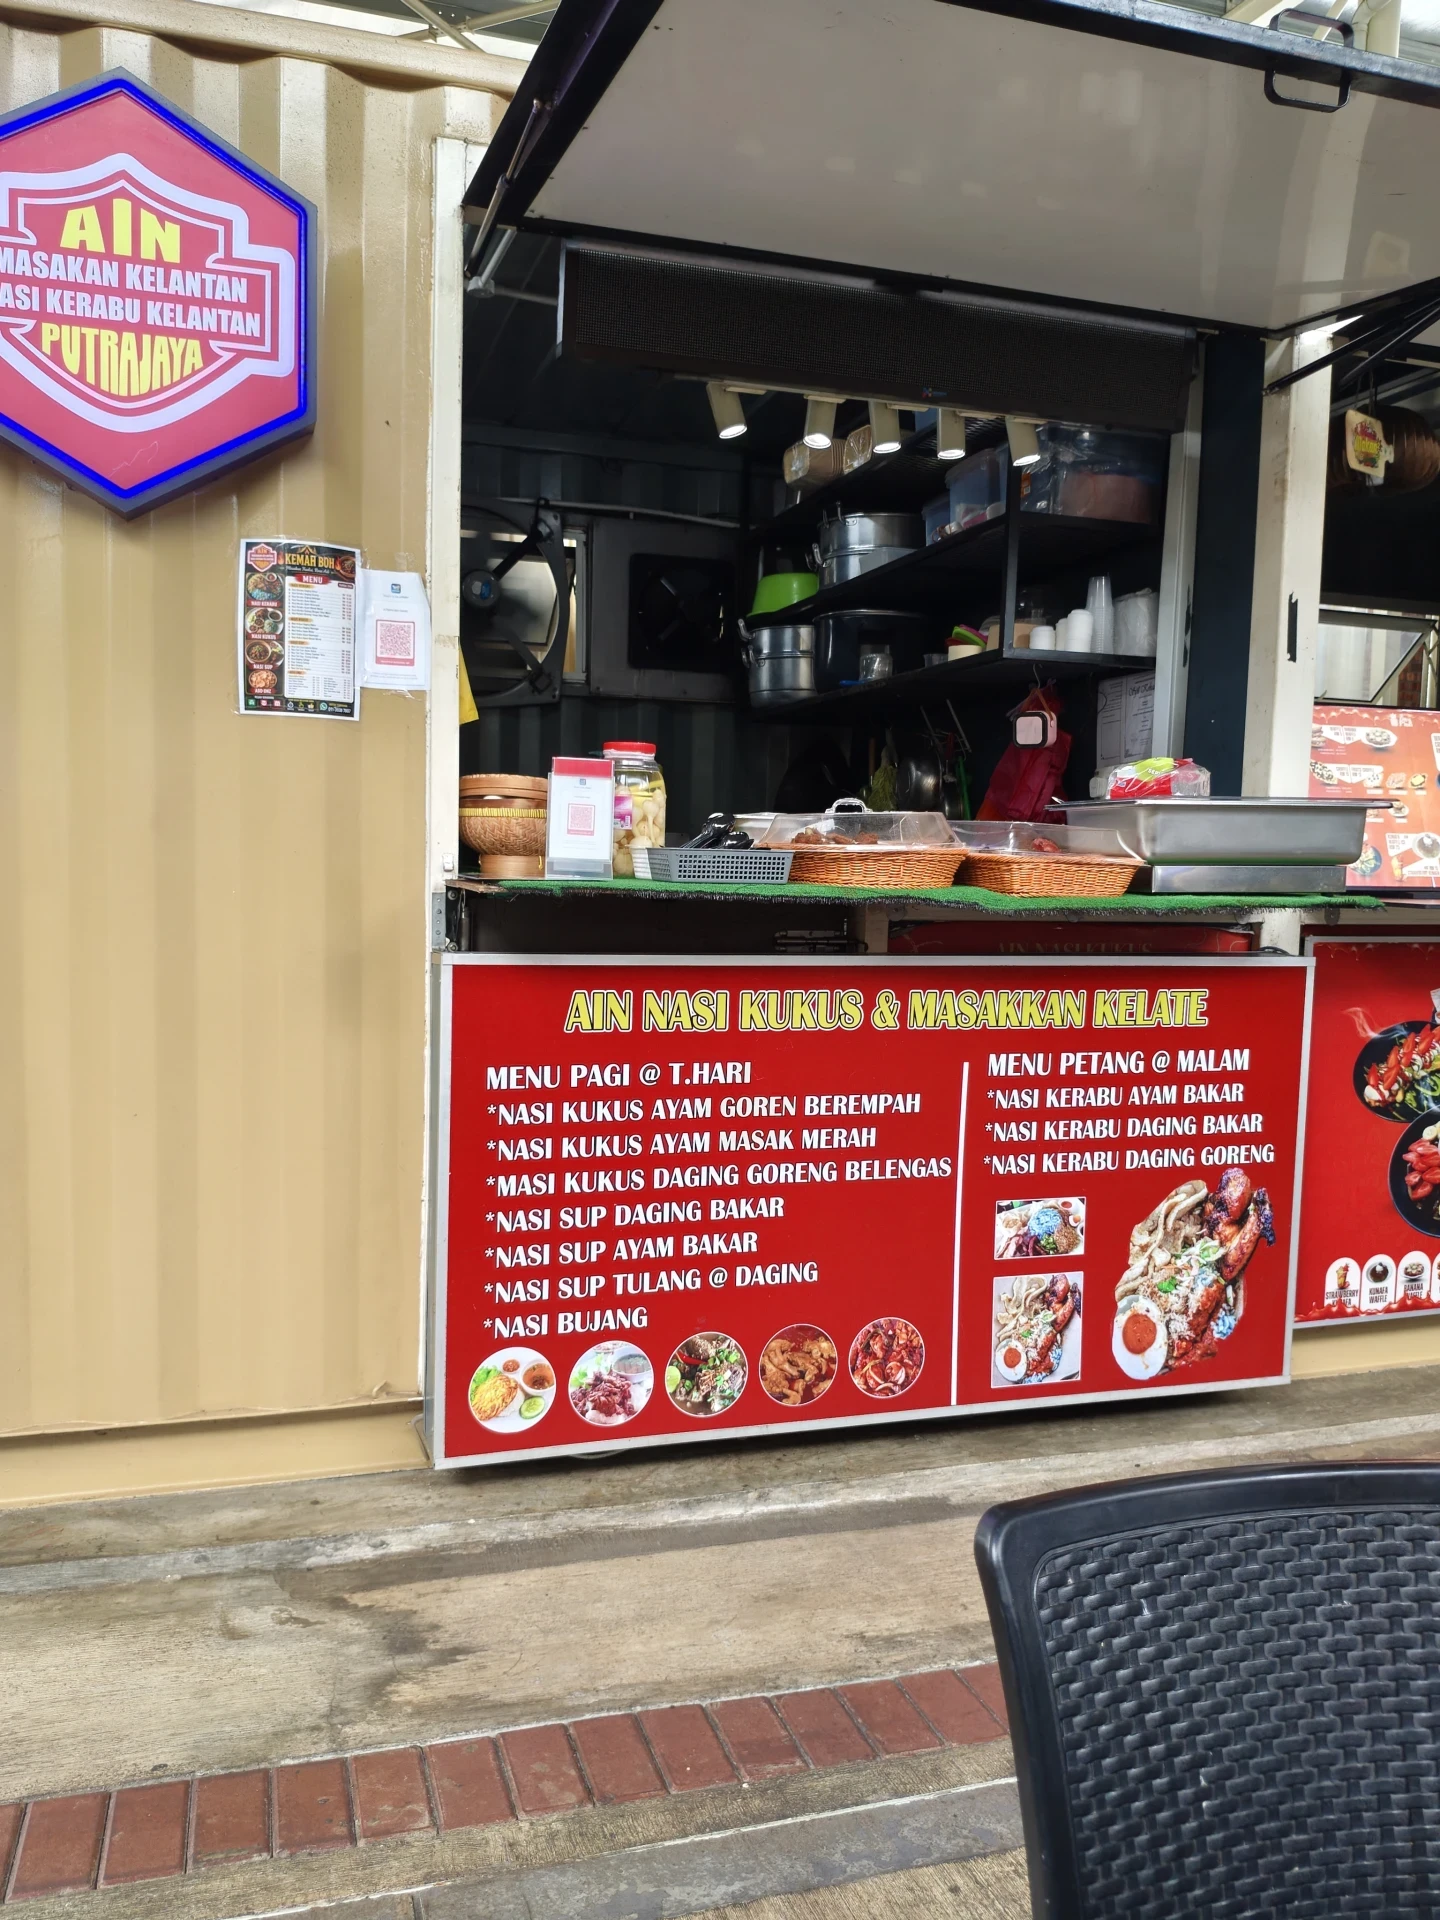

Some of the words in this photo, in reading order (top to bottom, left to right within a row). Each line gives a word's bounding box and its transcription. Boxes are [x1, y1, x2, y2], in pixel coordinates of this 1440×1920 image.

[59, 198, 181, 263] AIN
[0, 247, 118, 288] MASAKAN
[126, 264, 248, 303] KELANTAN
[46, 289, 141, 324] KERABU
[146, 302, 261, 337] KELANTAN
[41, 322, 203, 397] PUTRAJAYA
[285, 553, 317, 566] KEMAH
[302, 575, 323, 584] MENU
[564, 990, 633, 1033] AIN
[642, 990, 729, 1032] NASI
[739, 989, 864, 1031] KUKUS
[871, 989, 900, 1030] &
[907, 990, 1086, 1030] MASAKKAN
[1092, 989, 1209, 1028] KELATE
[487, 1066, 560, 1089] MENU
[571, 1064, 629, 1087] PAGI
[640, 1063, 660, 1085] @
[669, 1062, 751, 1084] T.HARI
[988, 1053, 1051, 1076] MENU
[1060, 1051, 1144, 1075] PETANG
[1152, 1051, 1170, 1073] @
[1177, 1049, 1249, 1072] MALAM
[563, 1100, 643, 1122] KUKUS
[651, 1098, 711, 1119] AYAM
[720, 1096, 796, 1117] GOREN
[805, 1094, 920, 1115] BEREMPAH
[1046, 1087, 1122, 1107] KERABU
[1128, 1085, 1177, 1105] AYAM
[1184, 1083, 1244, 1103] BAKAR
[1044, 1119, 1120, 1140] KERABU
[1127, 1116, 1196, 1137] DAGING
[1203, 1114, 1263, 1134] BAKAR
[562, 1135, 642, 1158] KUKUS
[650, 1132, 710, 1154] AYAM
[719, 1130, 794, 1151] MASAK
[802, 1128, 876, 1149] MERAH
[1043, 1151, 1119, 1172] KERABU
[1126, 1148, 1194, 1169] DAGING
[1201, 1144, 1274, 1165] GORENG
[565, 1169, 644, 1193] KUKUS
[654, 1165, 739, 1188] DAGING
[747, 1162, 837, 1184] GORENG
[846, 1157, 951, 1180] BELENGAS
[560, 1206, 606, 1228] SUP
[615, 1201, 701, 1226] DAGING
[711, 1197, 784, 1220] BAKAR
[559, 1241, 606, 1264] SUP
[613, 1237, 673, 1260] AYAM
[683, 1232, 757, 1255] BAKAR
[558, 1276, 605, 1299] SUP
[613, 1269, 701, 1294] TULANG
[709, 1267, 727, 1288] @
[736, 1262, 818, 1286] DAGING
[1326, 1289, 1358, 1299] STRAWBERRY
[1369, 1287, 1388, 1295] KUNAFA
[1369, 1295, 1388, 1304] WAFFLE
[558, 1307, 647, 1333] BUJANG
